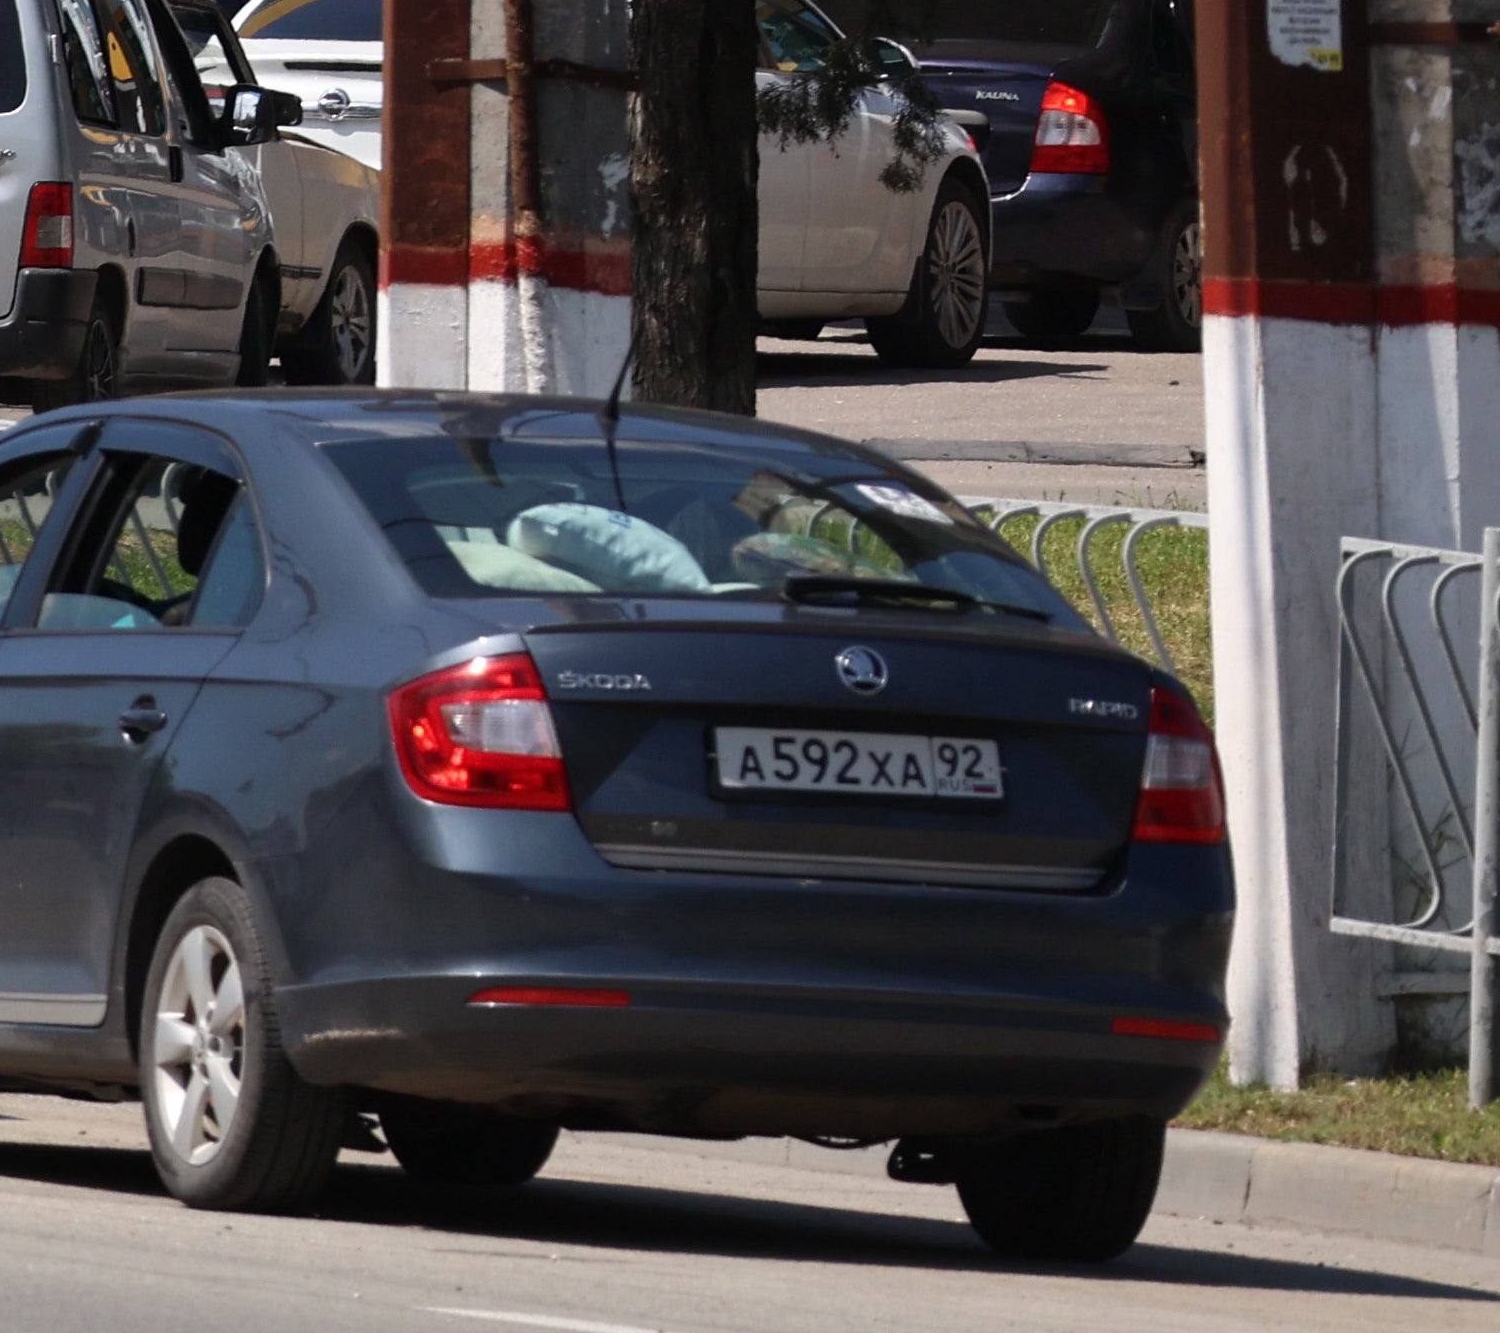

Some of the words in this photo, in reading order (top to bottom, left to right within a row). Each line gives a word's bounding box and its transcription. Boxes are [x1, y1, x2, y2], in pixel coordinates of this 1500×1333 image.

[1069, 699, 1139, 719] RAPID
[740, 736, 926, 789] А592ХА
[937, 742, 984, 779] 92
